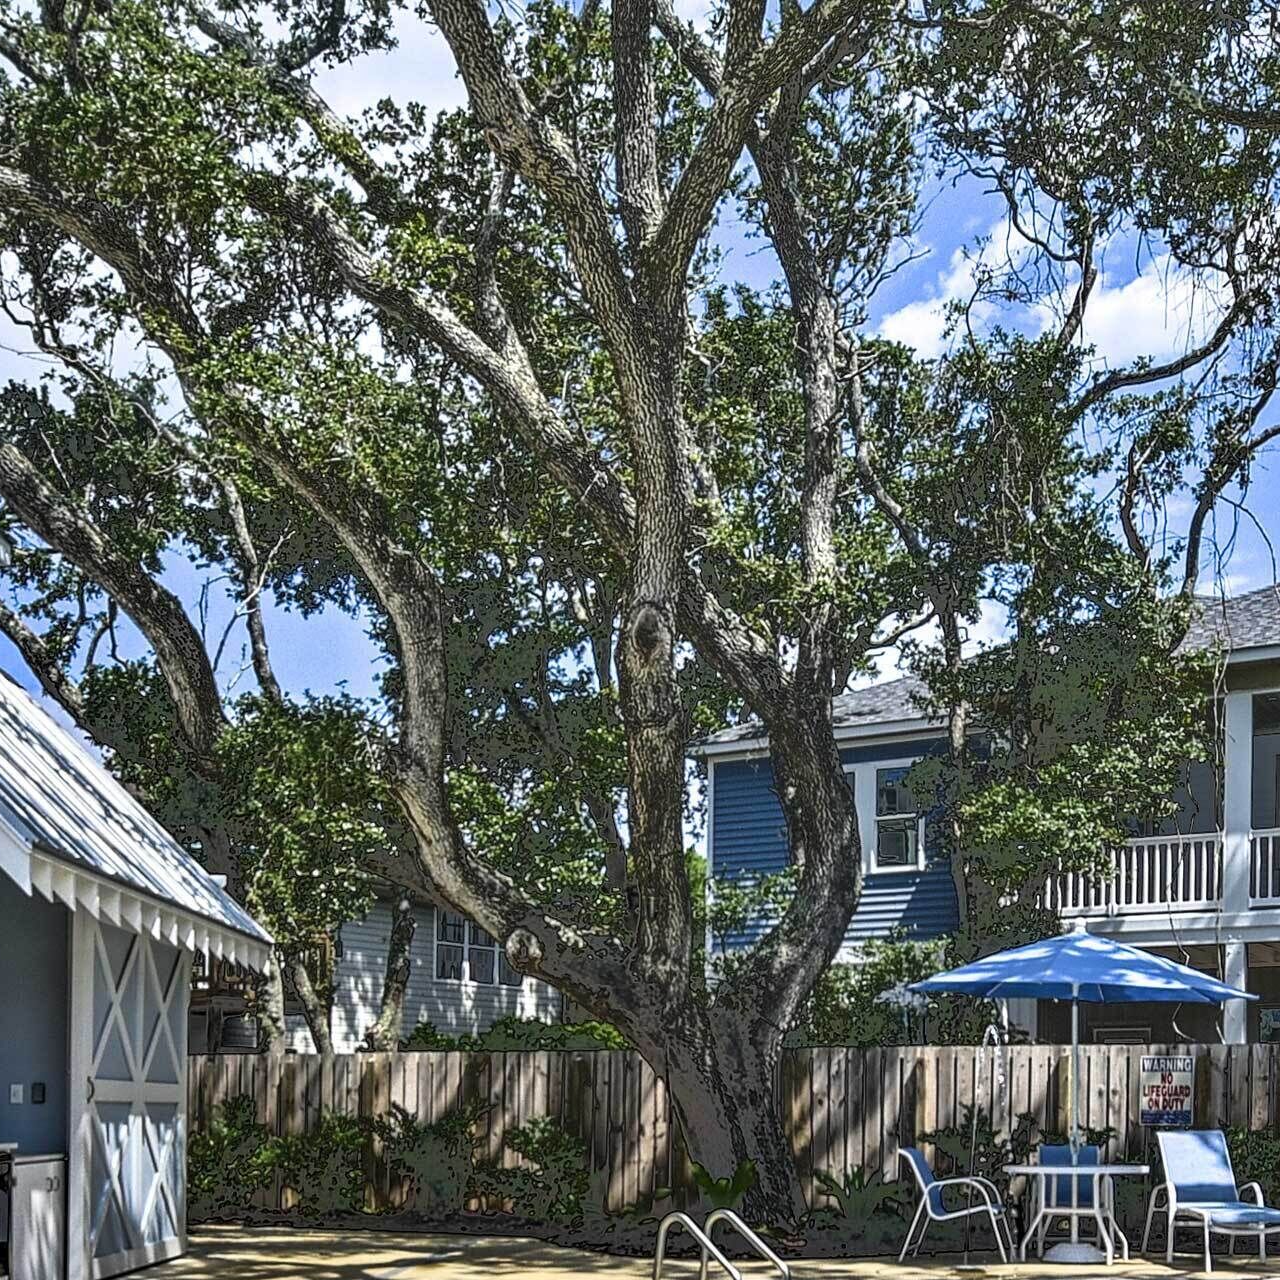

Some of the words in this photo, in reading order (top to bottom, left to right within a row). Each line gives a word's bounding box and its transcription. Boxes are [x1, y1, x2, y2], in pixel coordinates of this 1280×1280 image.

[1143, 1058, 1192, 1072] WARNING
[1161, 1072, 1174, 1085] NO
[1143, 1085, 1191, 1097] LIFEGUARD
[1148, 1097, 1160, 1110] ON
[1162, 1098, 1185, 1110] DUTY
